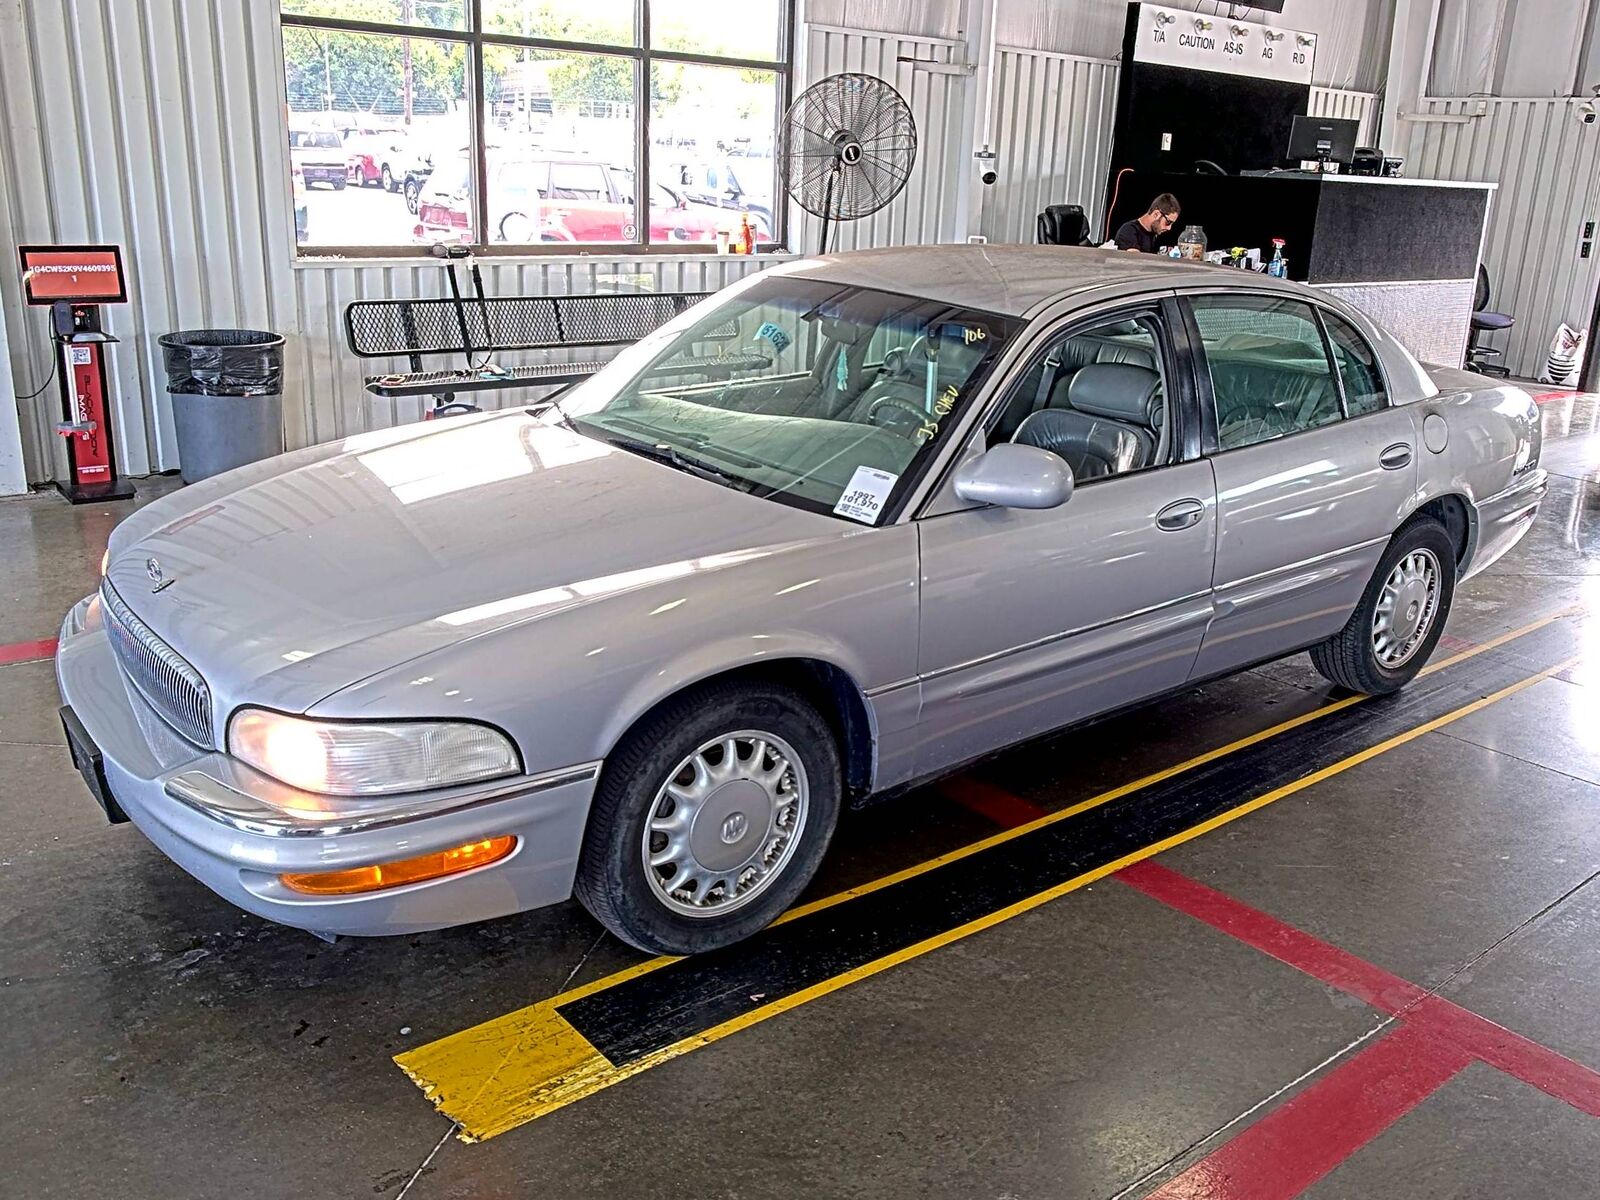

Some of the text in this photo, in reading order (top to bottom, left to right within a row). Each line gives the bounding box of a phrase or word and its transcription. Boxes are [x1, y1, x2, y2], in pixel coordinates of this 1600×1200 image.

[1153, 30, 1166, 43] T/A
[1178, 33, 1215, 51] CAUTION
[1223, 43, 1244, 55] AS-IS
[1261, 47, 1273, 59] AG
[71, 274, 78, 283] 1
[964, 327, 986, 345] 106
[83, 374, 96, 416] BLACK
[934, 384, 959, 416] CHEV
[853, 490, 876, 501] 1997
